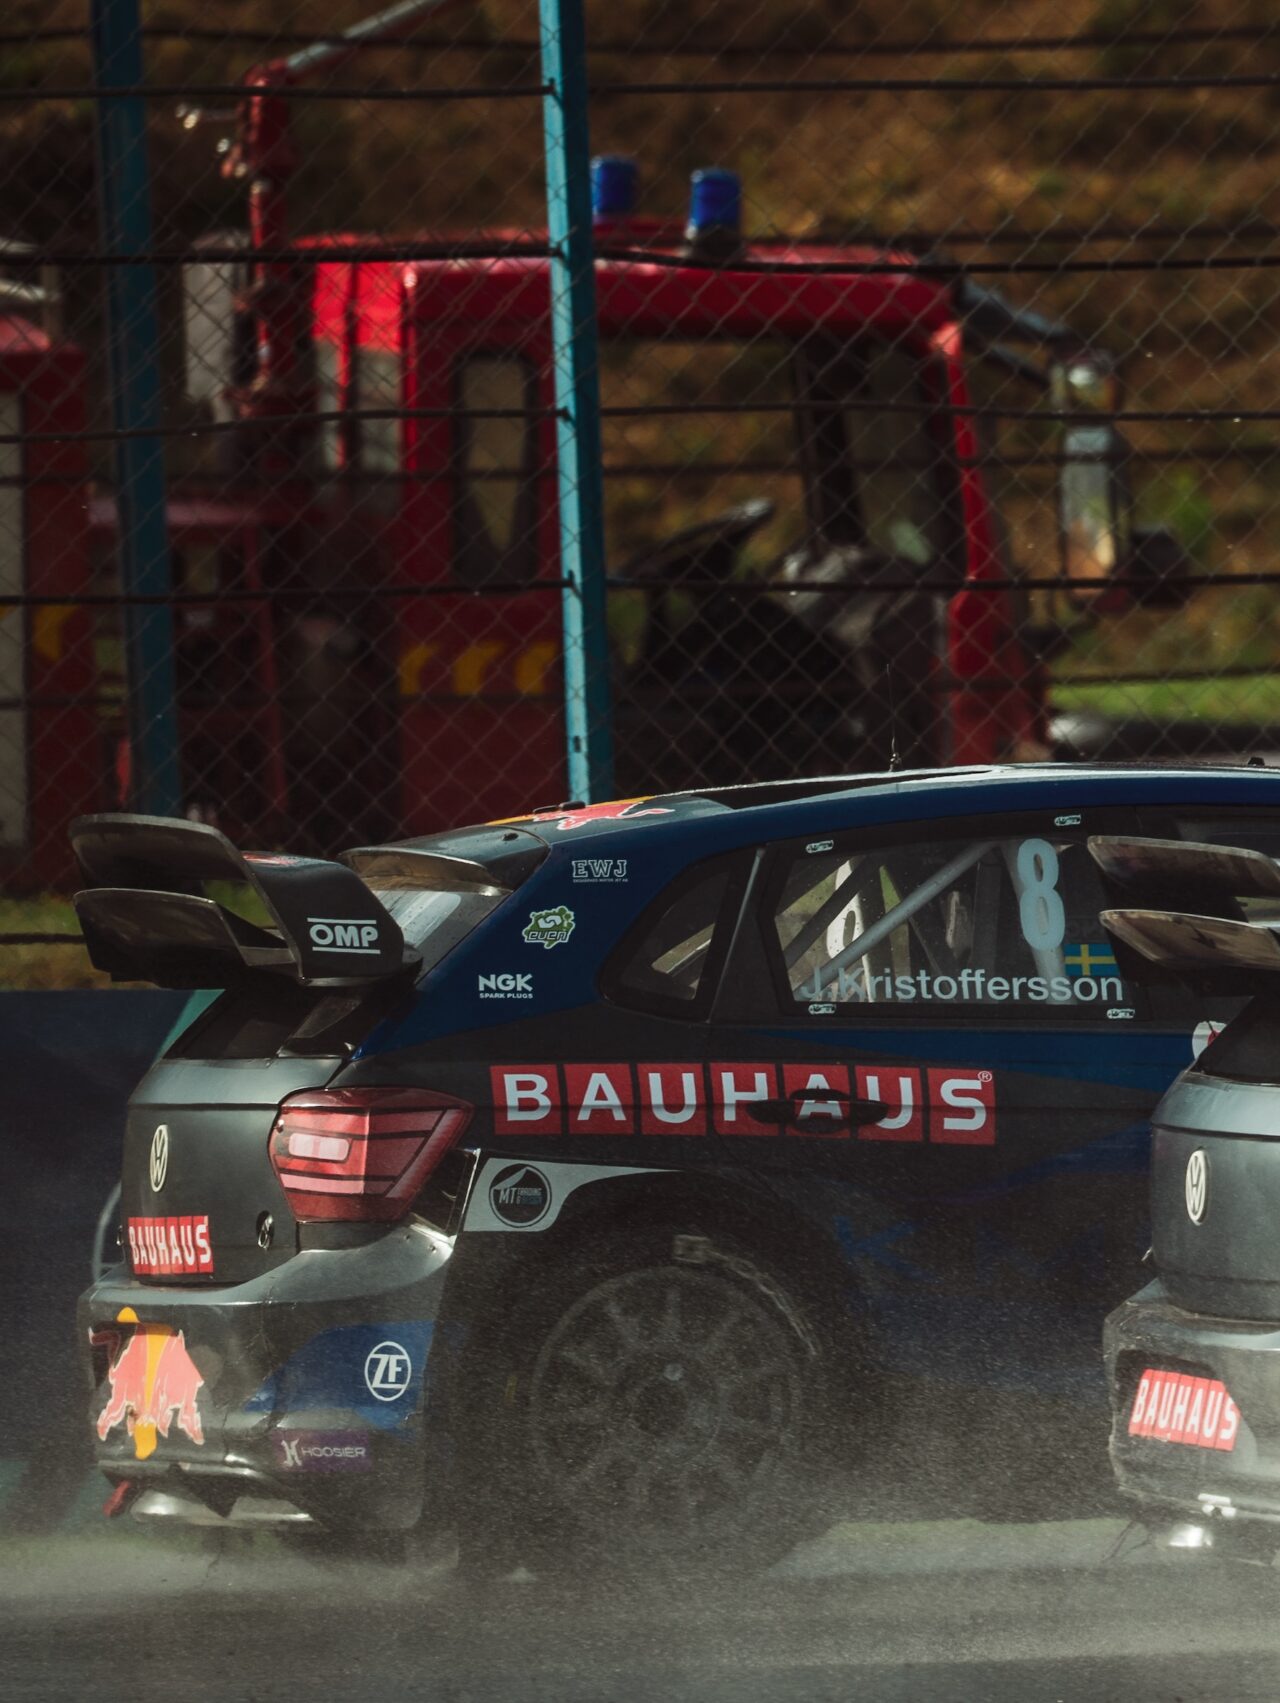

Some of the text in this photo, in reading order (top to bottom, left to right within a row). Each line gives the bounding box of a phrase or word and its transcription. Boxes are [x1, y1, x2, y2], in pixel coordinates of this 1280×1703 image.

[571, 859, 627, 878] EWJ
[1017, 838, 1066, 951] 8
[309, 923, 379, 949] OMP
[478, 973, 534, 992] NGK
[499, 1187, 517, 1204] MT
[129, 1223, 212, 1267] BAUHAUS
[368, 1353, 410, 1389] ZF
[1131, 1378, 1239, 1441] BAUHAUS
[301, 1446, 367, 1459] HOOSIER
